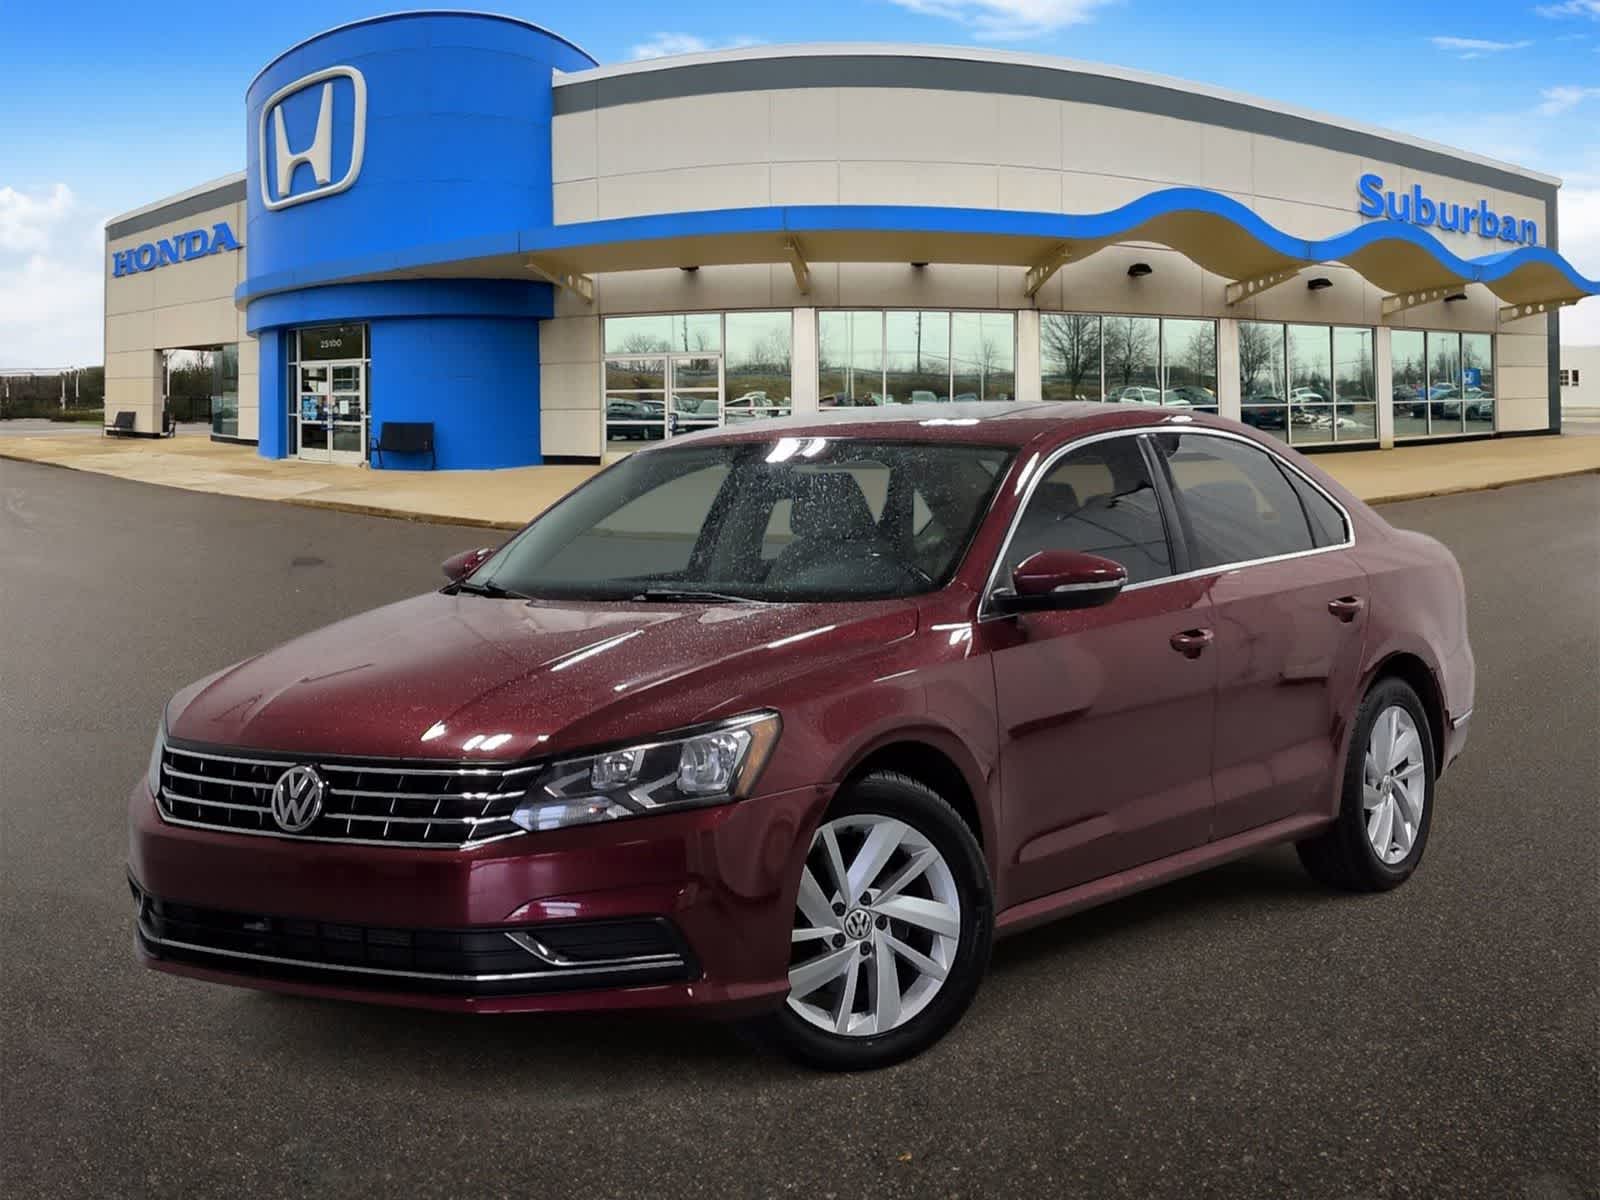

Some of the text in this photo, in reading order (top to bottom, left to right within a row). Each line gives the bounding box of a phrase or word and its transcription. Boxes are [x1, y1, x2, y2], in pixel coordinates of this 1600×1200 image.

[1358, 173, 1538, 246] Suburban
[112, 221, 241, 277] HONDA
[272, 765, 322, 831] VW
